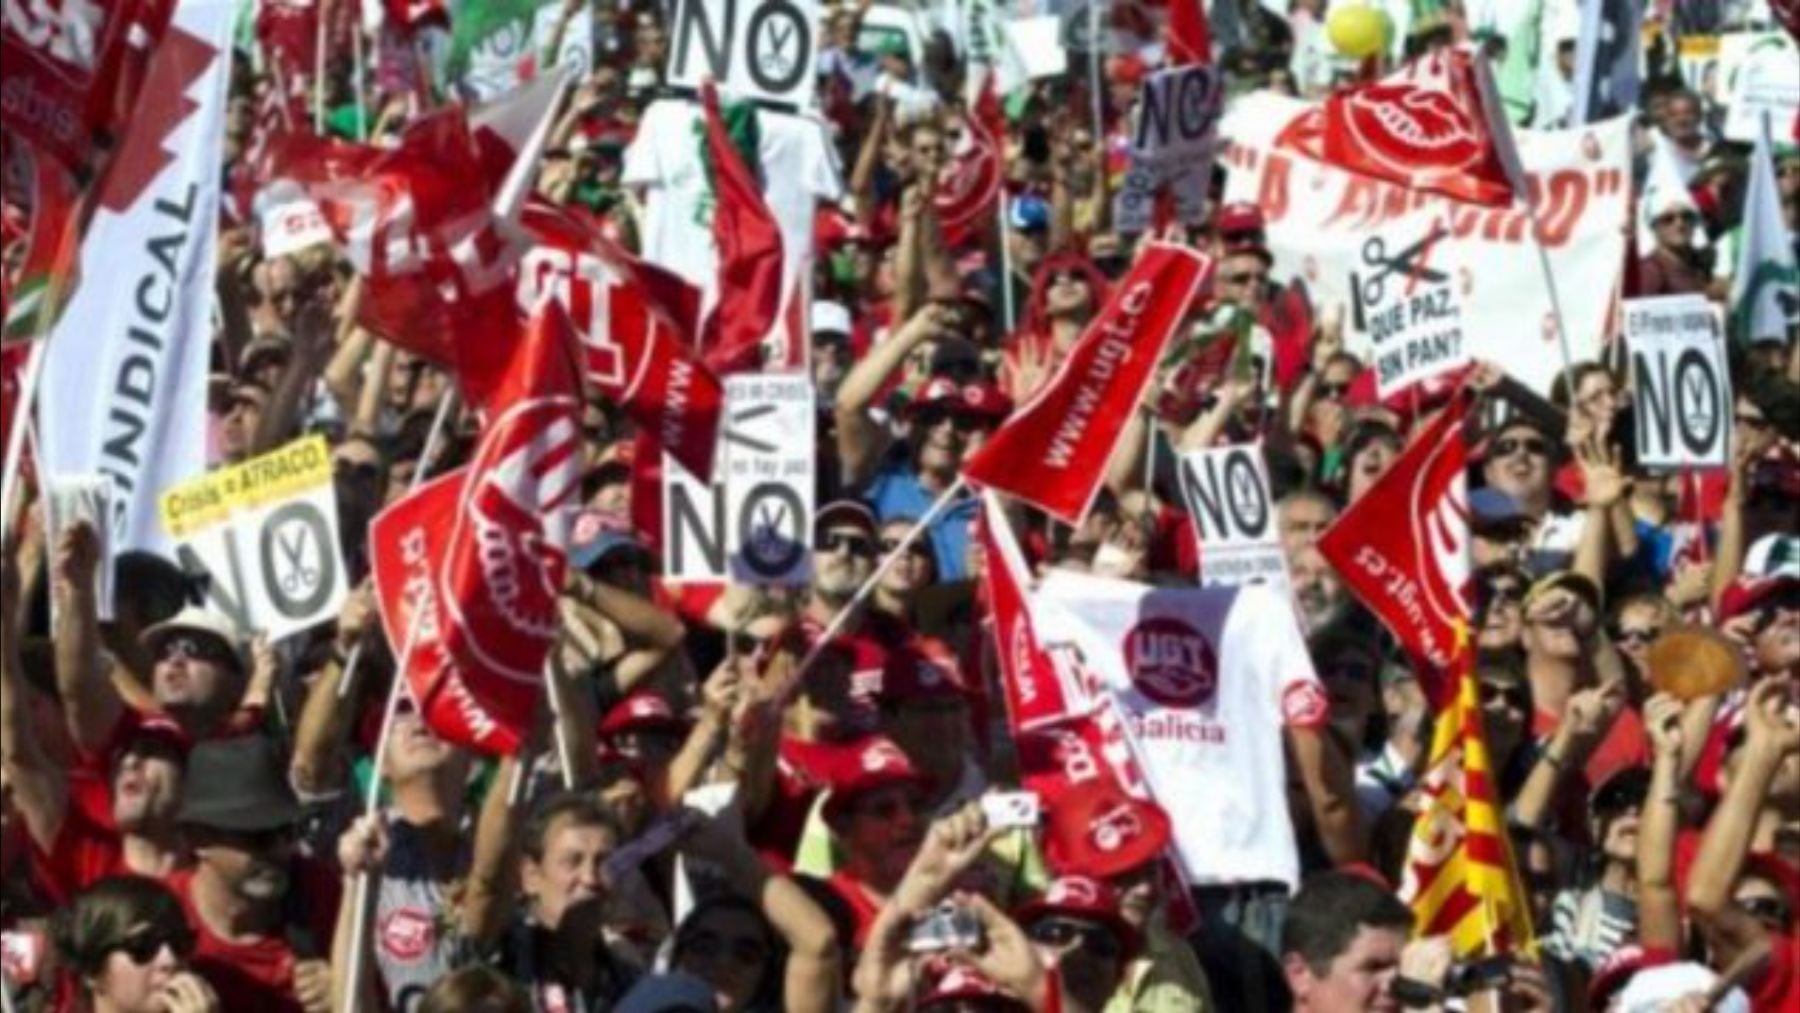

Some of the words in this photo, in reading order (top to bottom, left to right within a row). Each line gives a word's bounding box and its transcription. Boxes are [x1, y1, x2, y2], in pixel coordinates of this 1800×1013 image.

[674, 0, 811, 94] NO
[515, 246, 627, 346] GT
[1634, 348, 1719, 455] NO
[670, 482, 807, 578] NO
[1183, 450, 1268, 540] NO
[176, 501, 336, 636] NO
[1132, 630, 1206, 680] UGT
